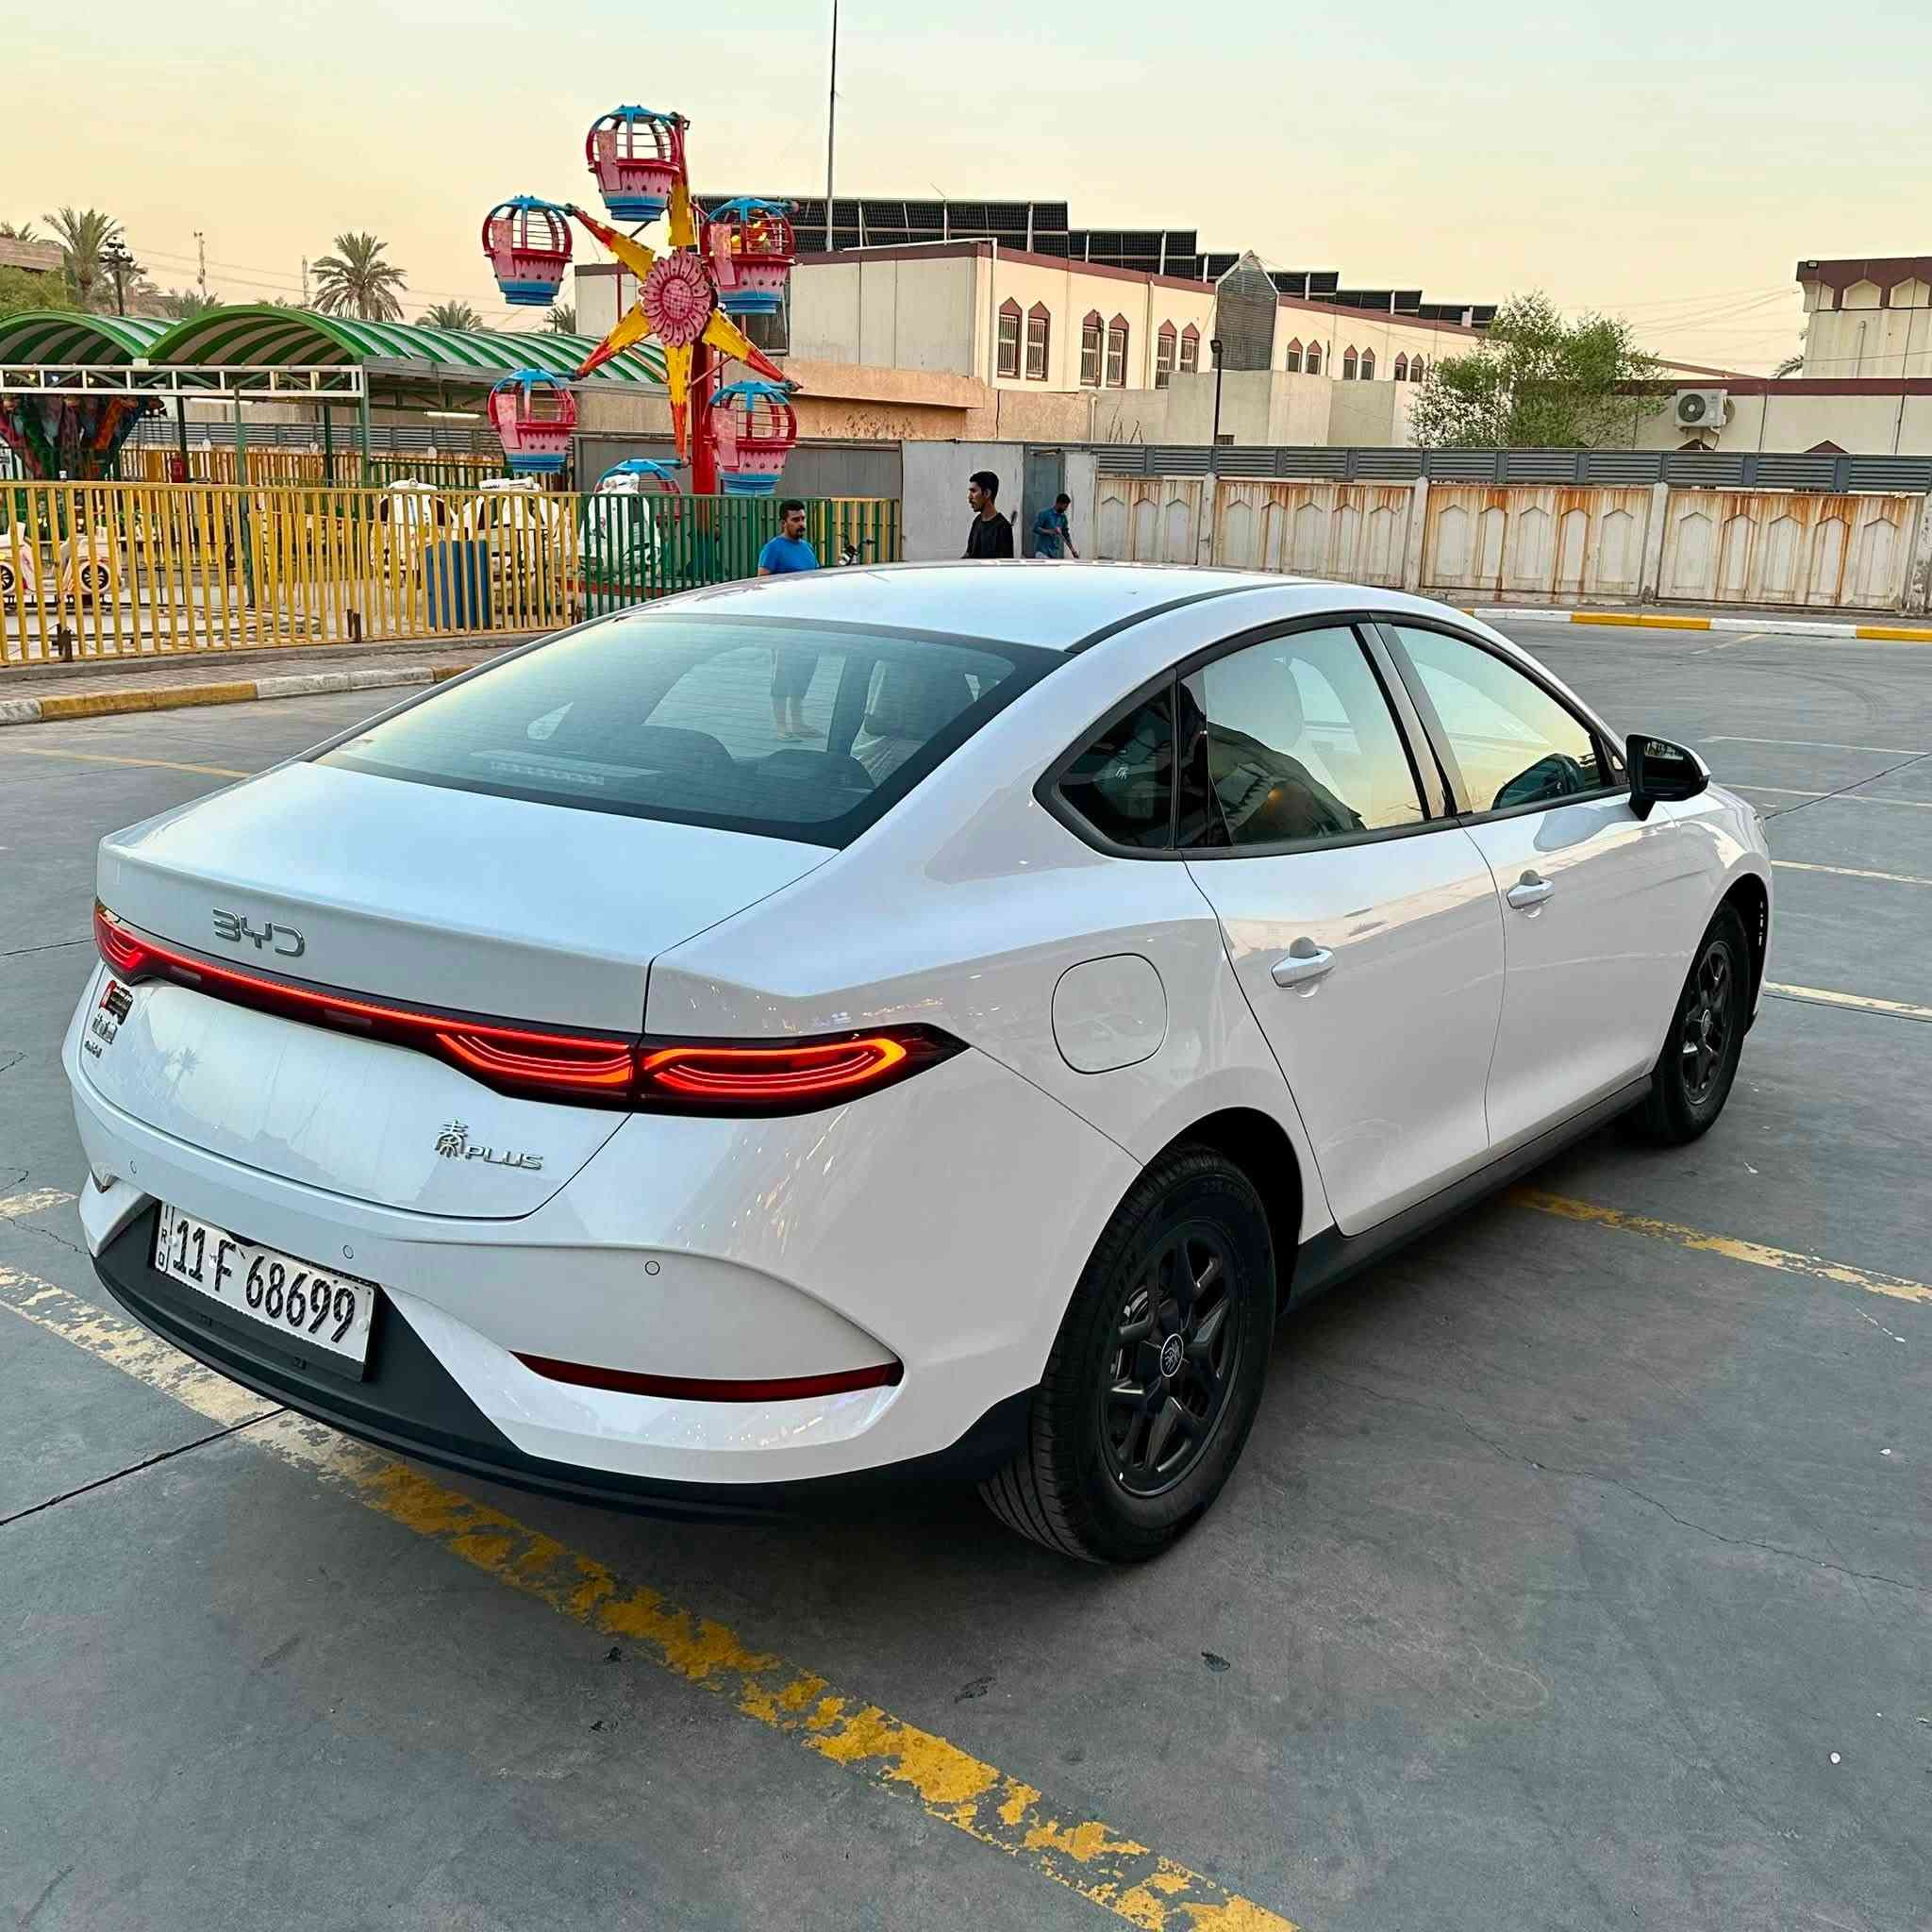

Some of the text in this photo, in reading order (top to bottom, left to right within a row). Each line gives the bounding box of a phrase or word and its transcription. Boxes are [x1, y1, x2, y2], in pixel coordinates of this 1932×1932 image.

[212, 907, 305, 958] BYD
[465, 1144, 543, 1171] PLUS
[174, 1219, 356, 1343] 11 F 68699
